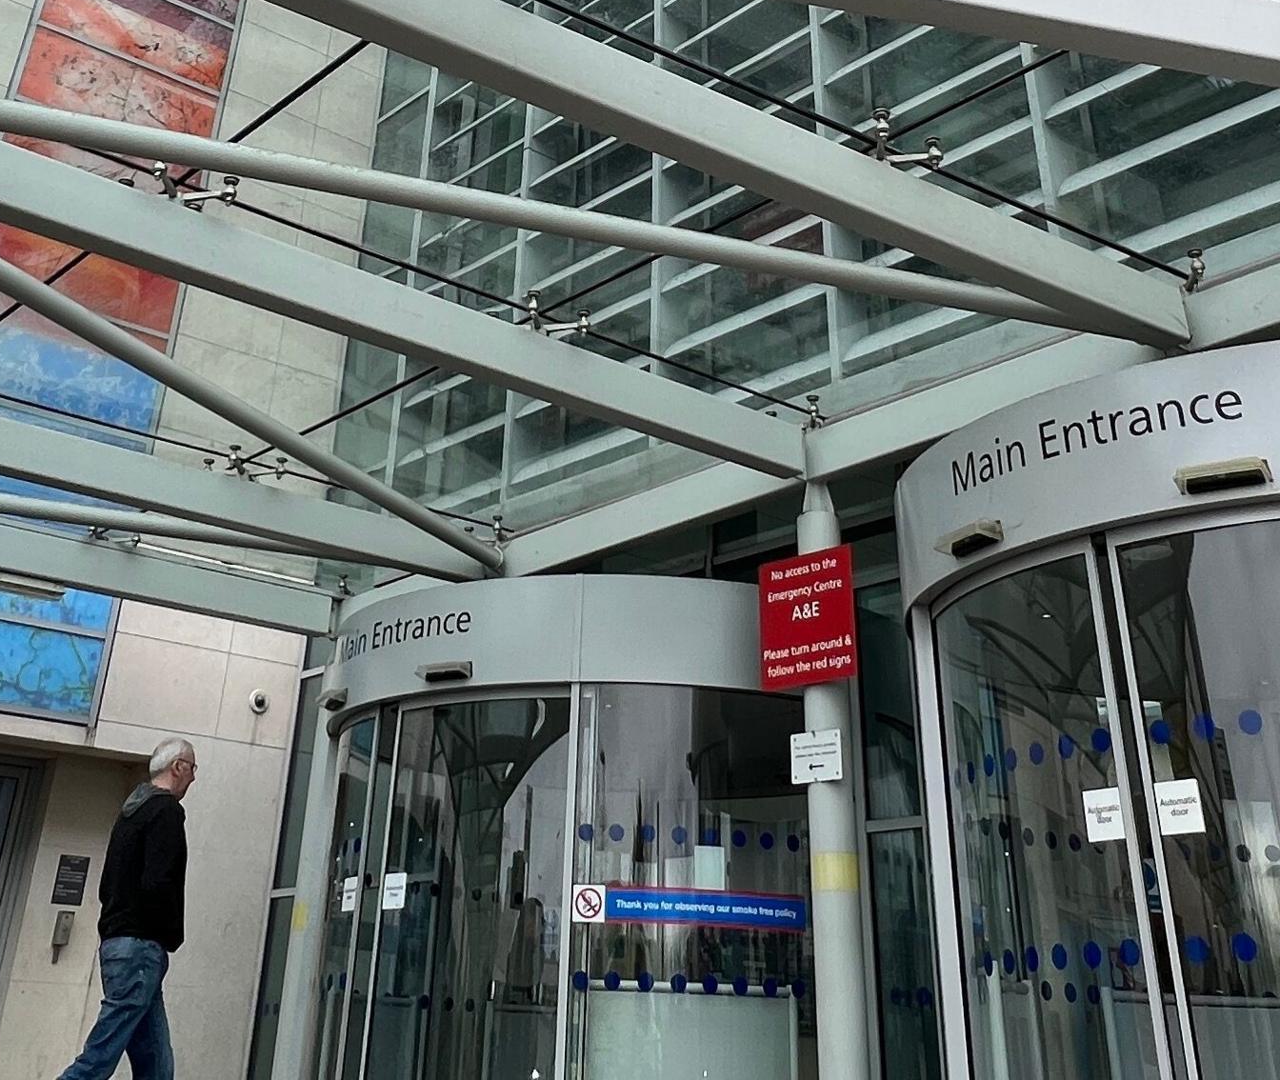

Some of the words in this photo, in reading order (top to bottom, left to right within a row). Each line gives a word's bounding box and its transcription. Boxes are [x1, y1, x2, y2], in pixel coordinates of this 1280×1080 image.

[951, 437, 1026, 496] Main
[1038, 389, 1243, 460] Entrance
[771, 571, 783, 581] No
[784, 565, 810, 579] access
[811, 562, 821, 573] to
[822, 558, 837, 570] the
[767, 585, 812, 603] Emergency
[813, 579, 842, 593] Centre
[791, 601, 820, 621] A&E
[371, 611, 472, 650] Entrance
[763, 648, 789, 660] Please
[791, 645, 810, 656] turn
[811, 636, 842, 652] around
[844, 633, 852, 646] &
[767, 665, 795, 678] follow
[795, 660, 811, 673] the
[812, 656, 828, 670] red
[829, 654, 852, 670] signs
[616, 899, 642, 909] Thank
[643, 902, 660, 911] you
[661, 900, 673, 910] for
[674, 903, 715, 914] observing
[732, 906, 758, 914] smoke
[759, 907, 774, 916] free
[774, 908, 797, 919] policy
